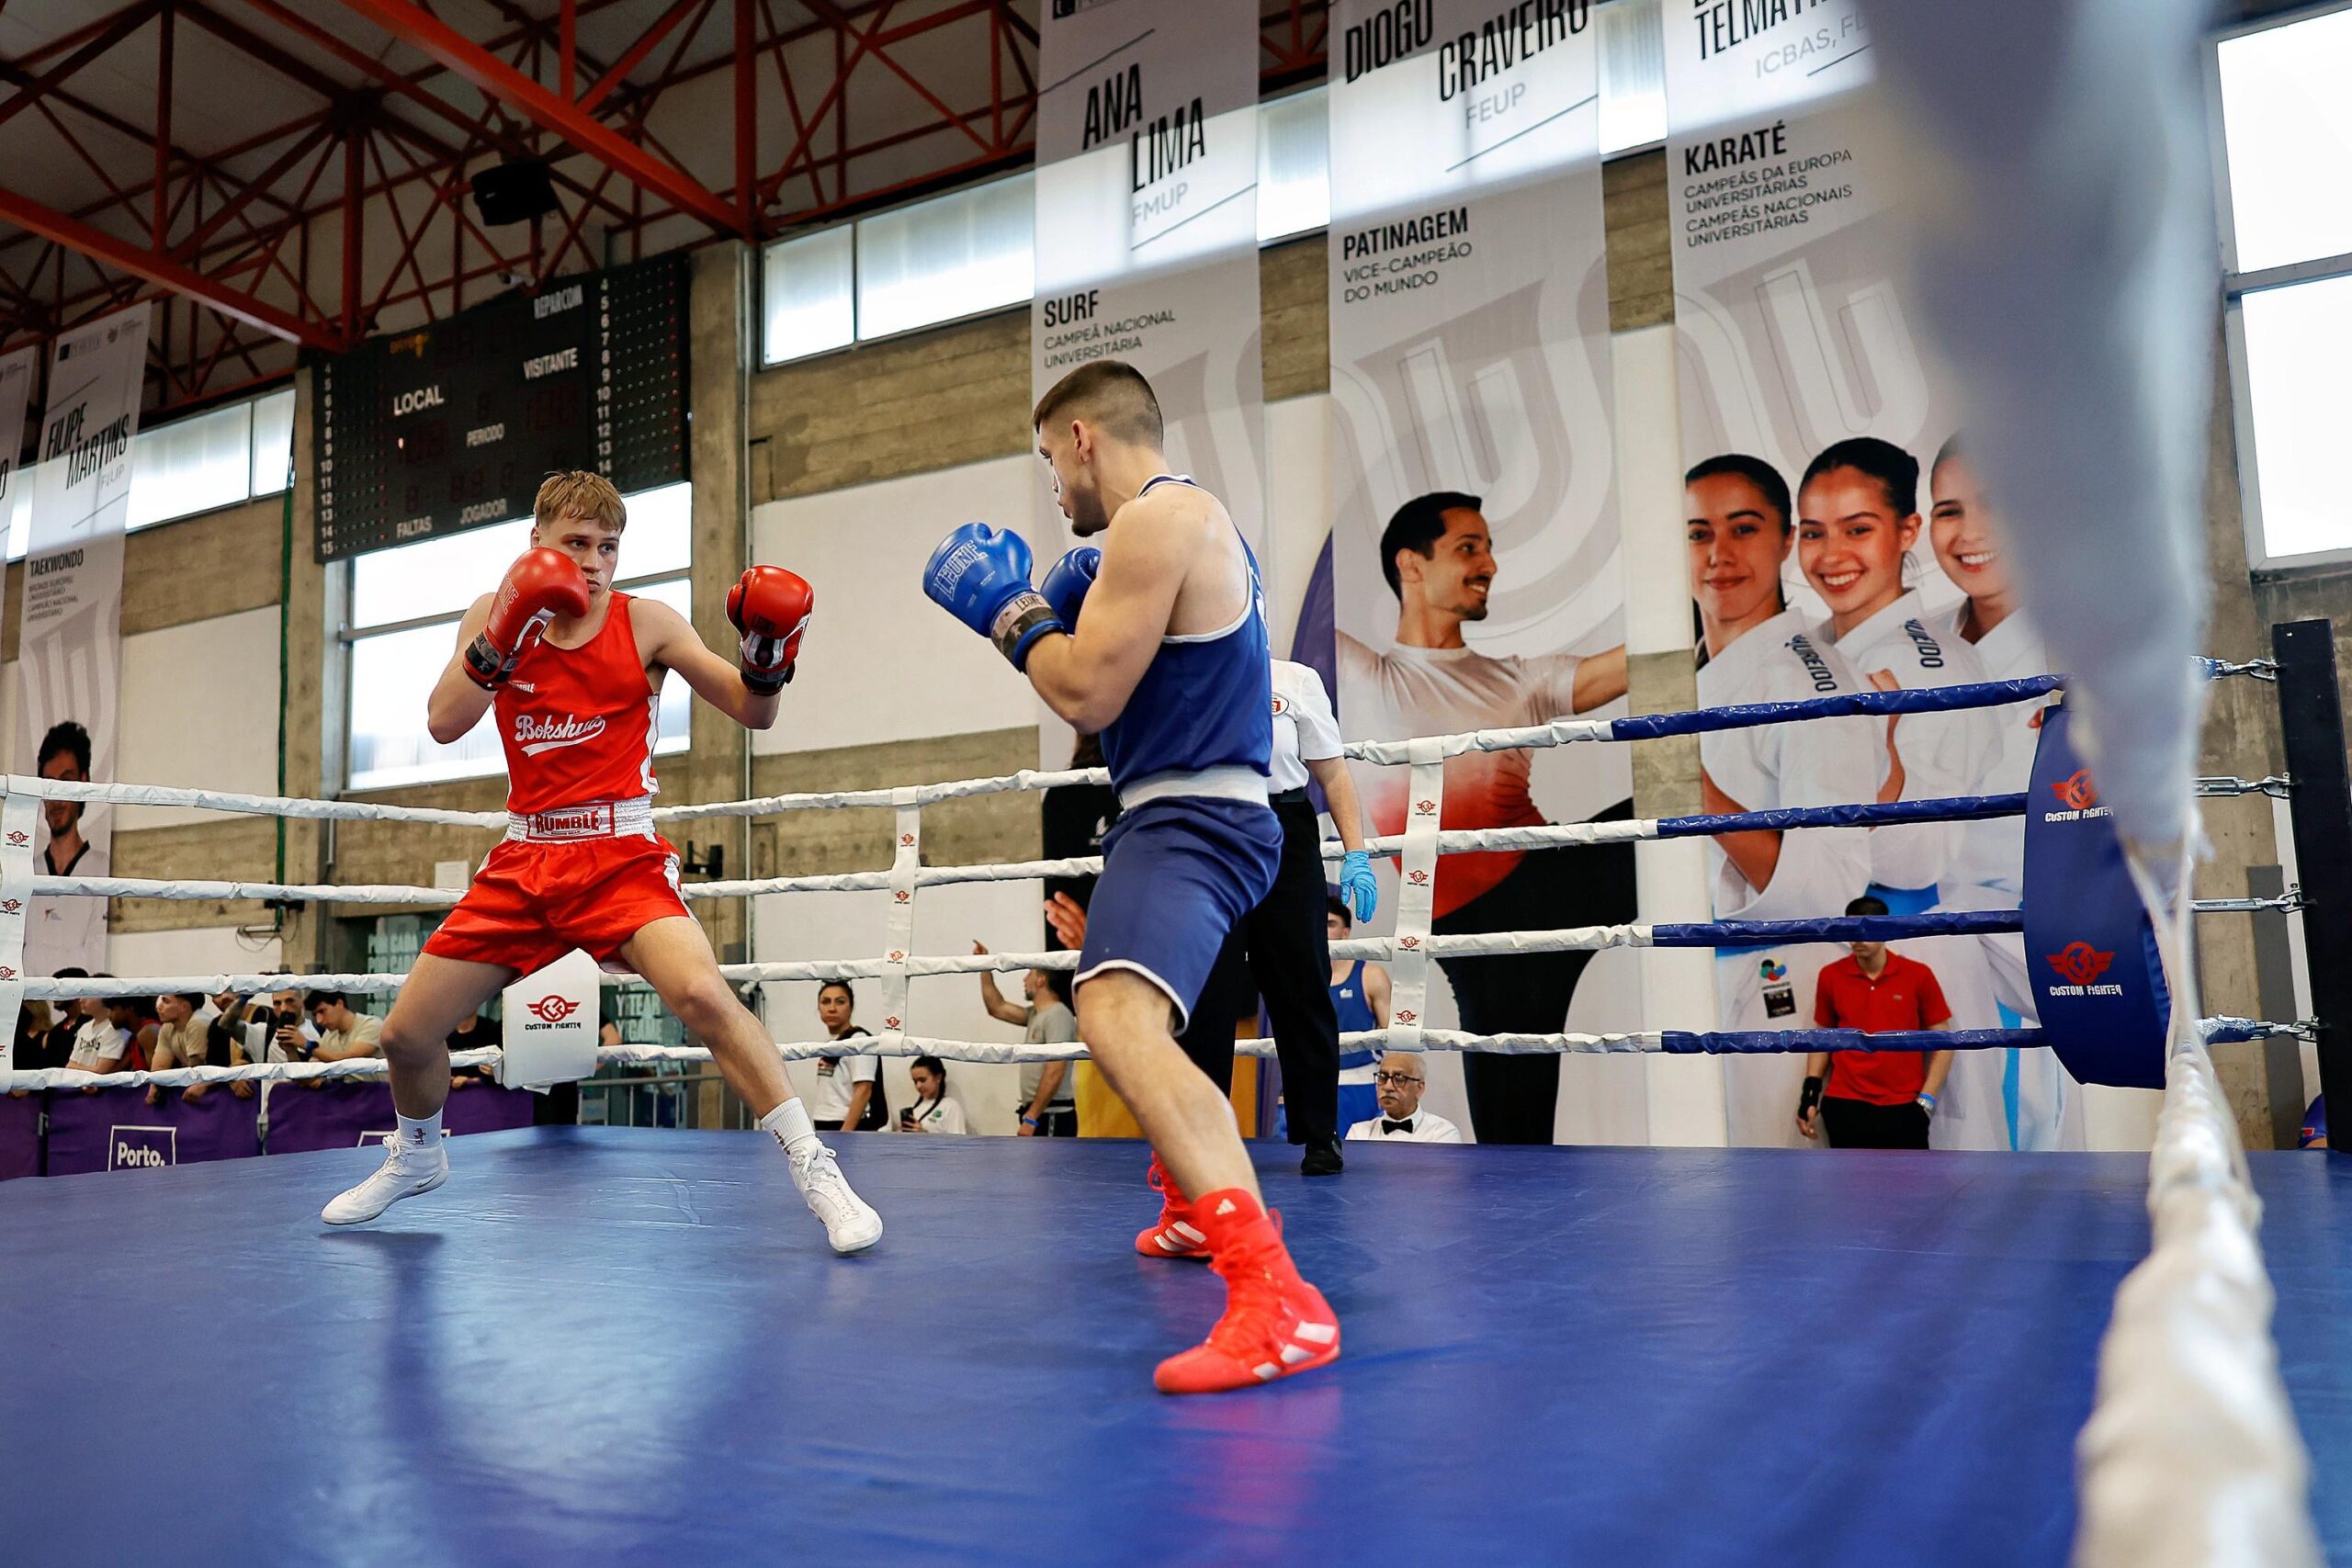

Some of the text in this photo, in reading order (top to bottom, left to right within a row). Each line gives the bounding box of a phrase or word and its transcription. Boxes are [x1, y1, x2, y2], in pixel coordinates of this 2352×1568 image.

[1757, 28, 1837, 78] ICBAS,
[1082, 63, 1142, 151] ANA
[1466, 82, 1526, 129] FEUP
[1132, 96, 1204, 193] LIMA
[1685, 119, 1787, 175] KARATÉ
[1684, 149, 1852, 198] CAMPEÃS DA EUROPA
[1132, 183, 1188, 227] FMUP
[1686, 185, 1852, 233] CAMPEÃS NACIONAIS
[1343, 207, 1468, 261] PATINAGEM
[1344, 242, 1472, 283] VICE-CAMPEÃO
[1344, 270, 1439, 303] DO MUNDO
[1044, 289, 1099, 328] SURF
[1103, 310, 1175, 337] NACIONAL
[601, 331, 609, 346] 7
[523, 347, 579, 379] VISITANTE
[393, 385, 446, 417] LOCAL
[597, 404, 610, 420] 11
[46, 402, 87, 462] FILIPE
[66, 413, 130, 490] MARTINS
[397, 516, 433, 539] FALTAS
[30, 548, 84, 577] TAEKWONDO
[933, 539, 989, 602] LEONE
[535, 810, 600, 833] RUMBLE
[2045, 810, 2079, 822] CUSTOM
[2050, 984, 2122, 997] CUSTOM FIGHTER
[117, 1142, 165, 1167] Porto.
